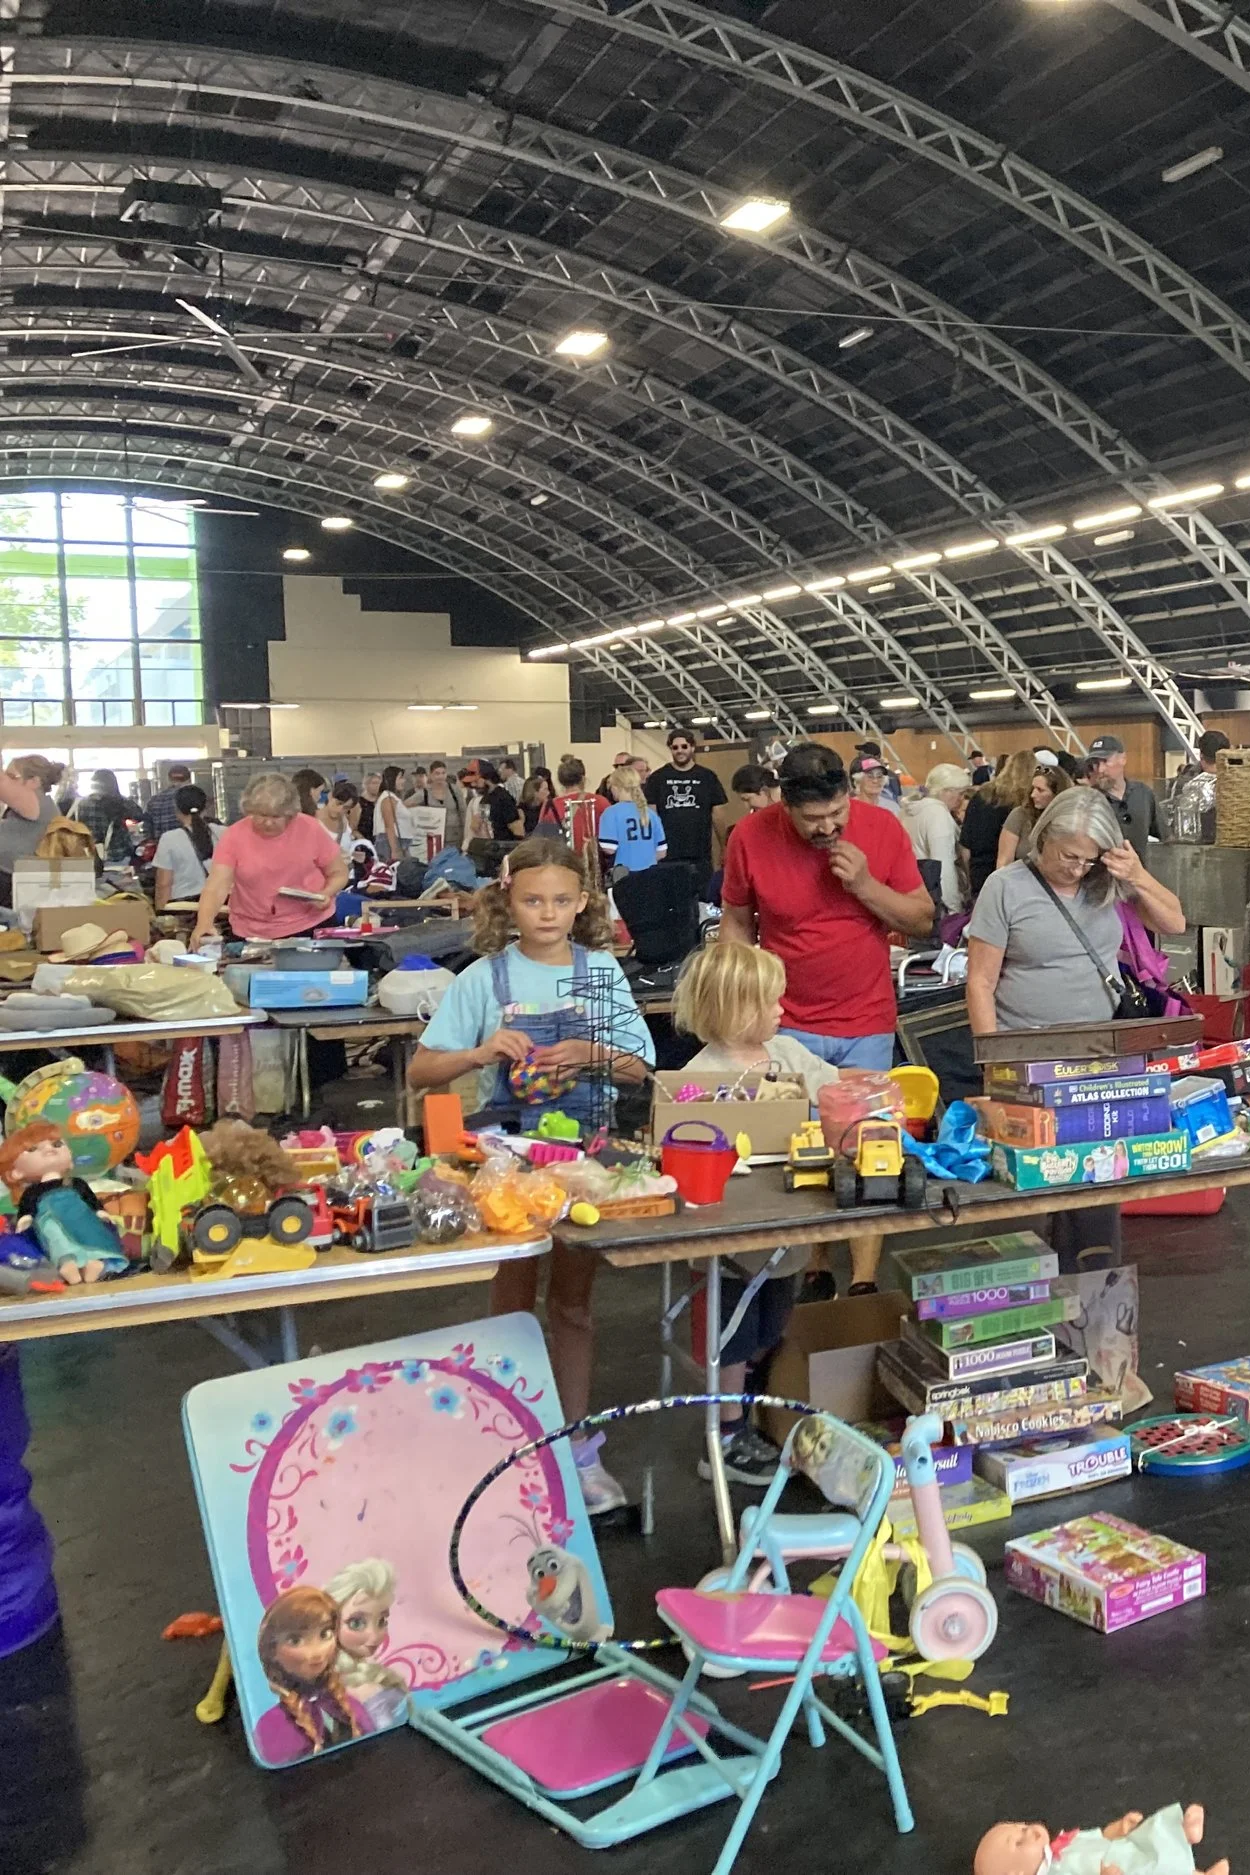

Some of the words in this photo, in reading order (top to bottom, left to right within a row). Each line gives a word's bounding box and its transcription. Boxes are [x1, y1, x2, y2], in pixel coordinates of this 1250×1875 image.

[1079, 1083, 1113, 1093] Children's
[1115, 1078, 1149, 1089] Illustrated
[1071, 1092, 1099, 1104] ATLAS
[1101, 1086, 1149, 1101] COLLECTION
[1103, 1102, 1111, 1138] CODING
[1153, 1136, 1188, 1156] GROW!
[1158, 1153, 1188, 1170] GO!
[971, 1287, 1008, 1303] 1000
[966, 1350, 995, 1367] 1000
[975, 1420, 1020, 1438] Nabisco
[1021, 1414, 1066, 1432] Cookies
[1069, 1447, 1127, 1477] TROUBLE
